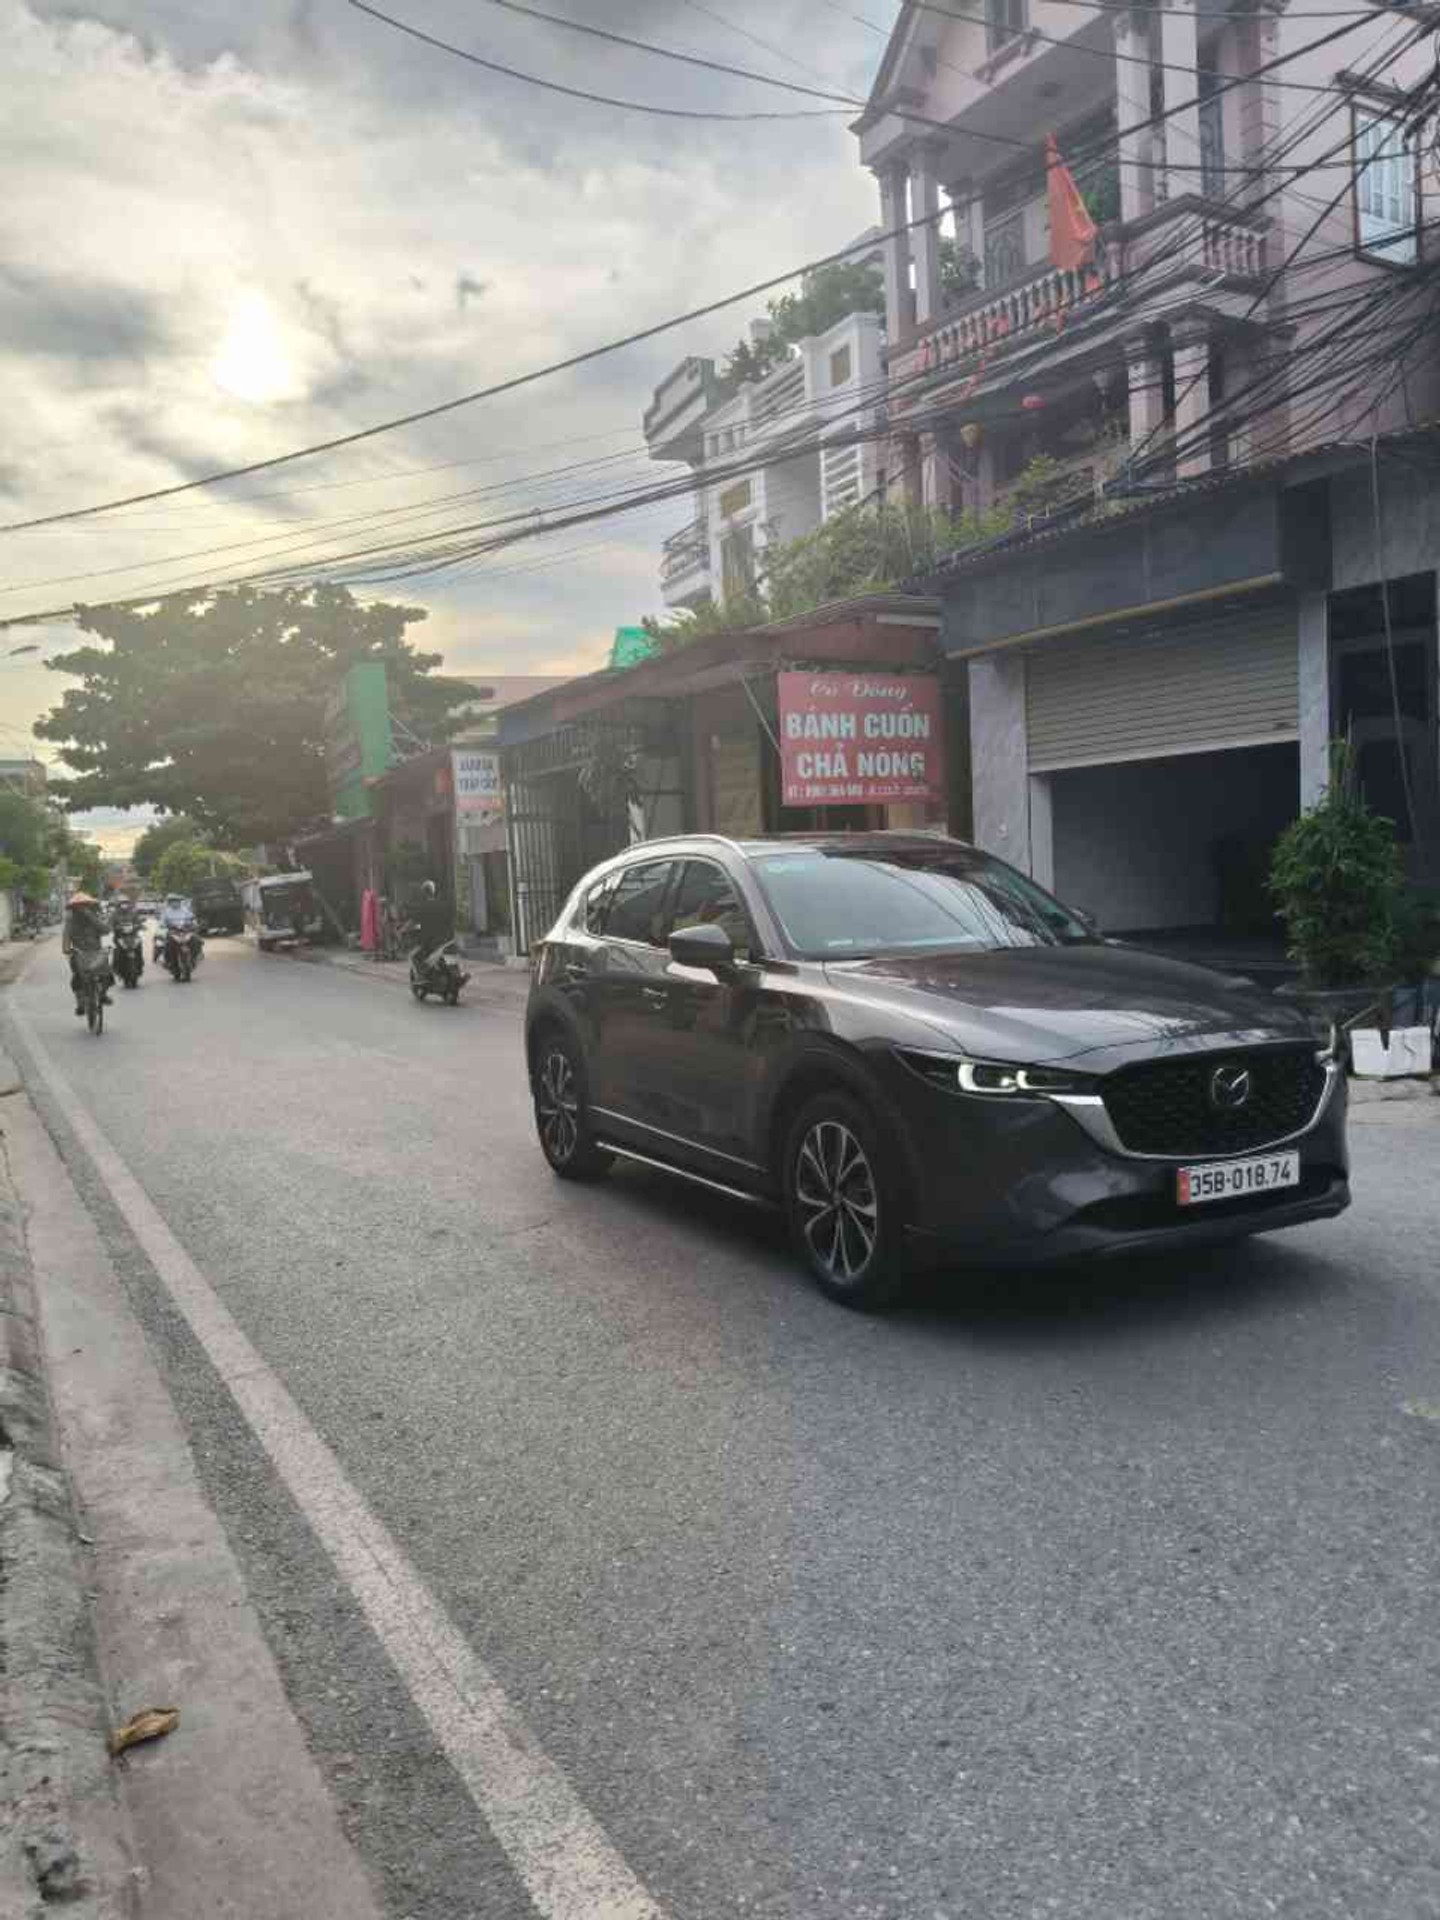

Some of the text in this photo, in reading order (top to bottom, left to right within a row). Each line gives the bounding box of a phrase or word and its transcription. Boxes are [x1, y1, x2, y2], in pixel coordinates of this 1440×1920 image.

[785, 702, 930, 739] BÁNH CUỐN
[796, 742, 849, 779] CHẢ
